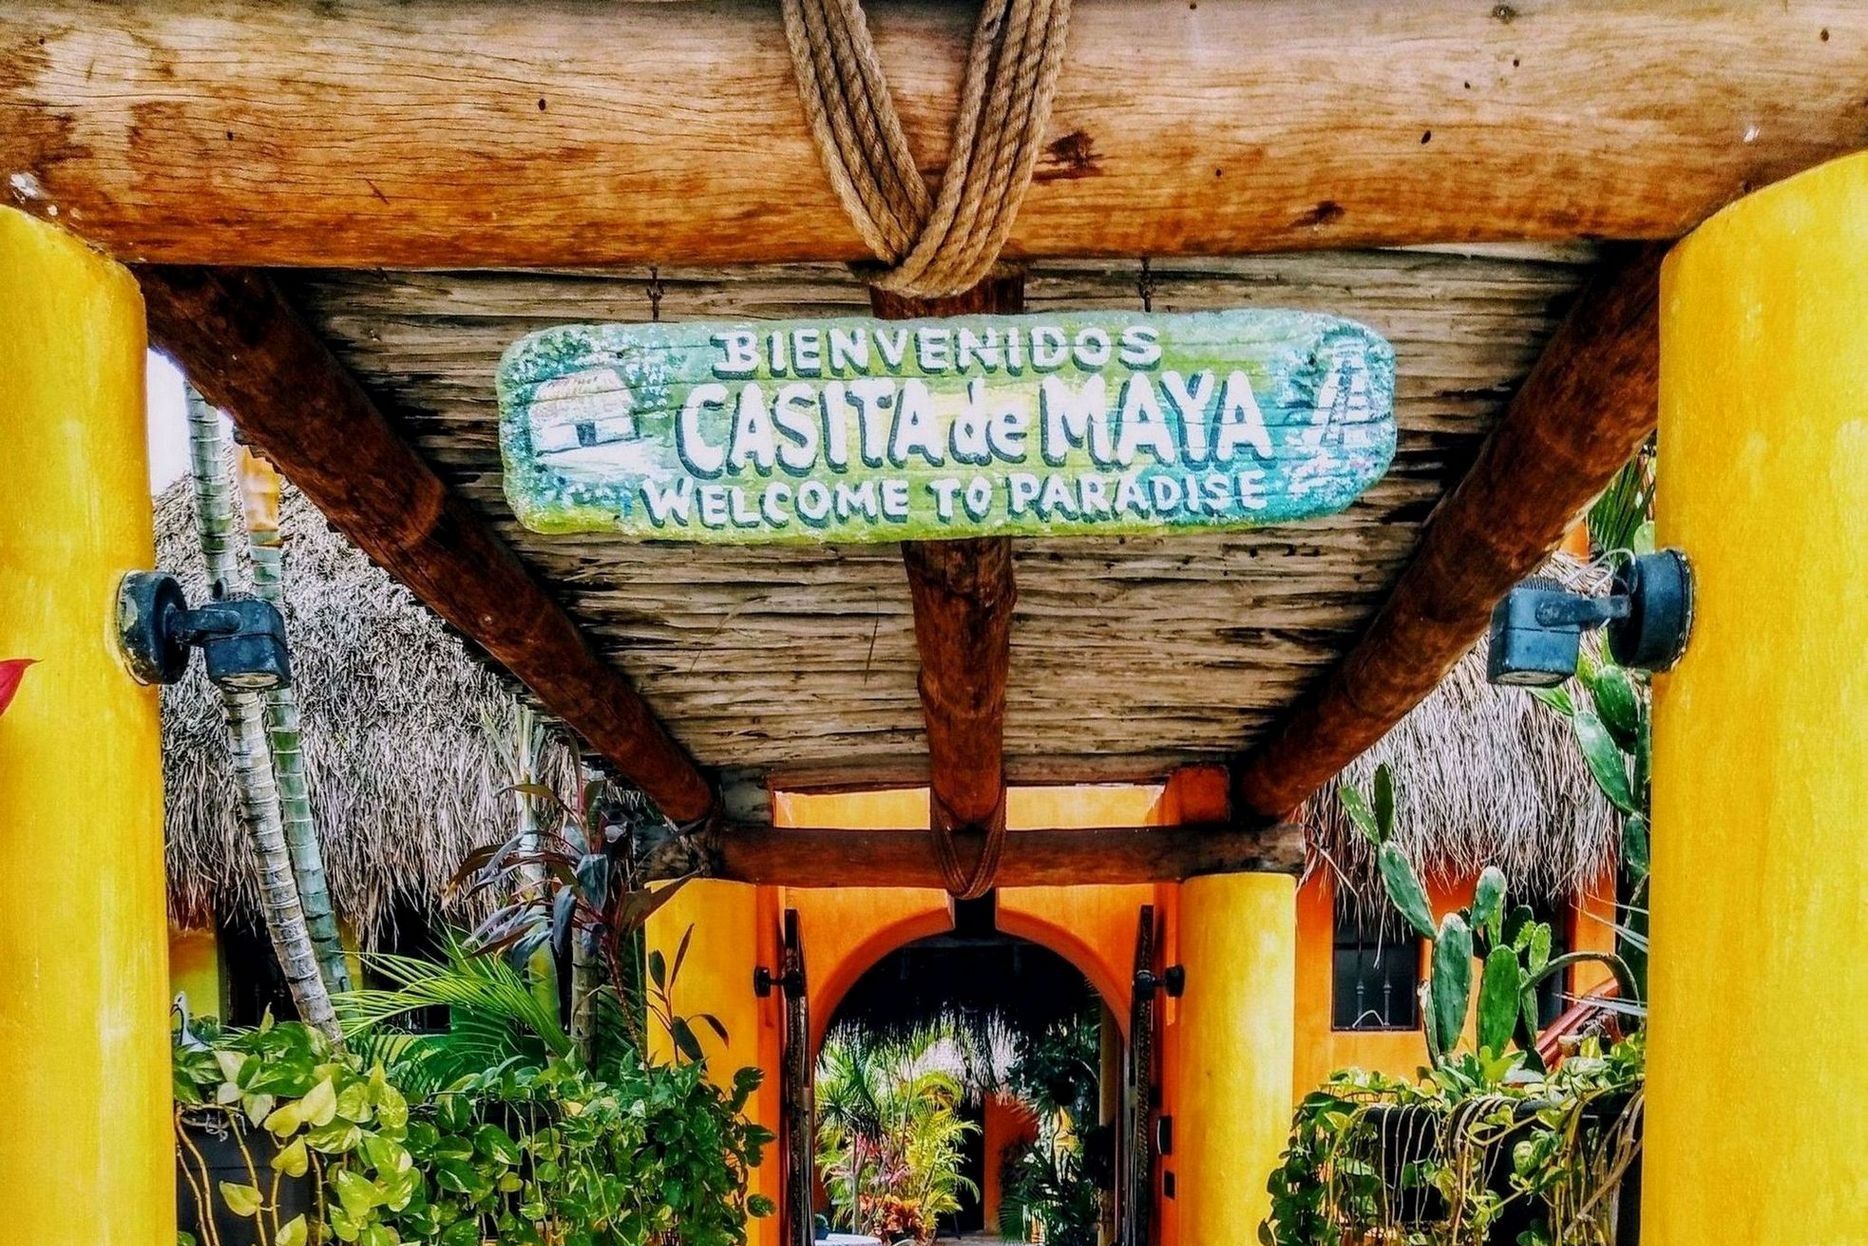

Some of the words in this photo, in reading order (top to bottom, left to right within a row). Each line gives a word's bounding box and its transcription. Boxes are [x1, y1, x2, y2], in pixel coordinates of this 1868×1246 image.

[709, 325, 1163, 380] BIENVENIDOS
[675, 377, 945, 480] CASITA
[948, 377, 1030, 467] de
[1038, 369, 1278, 472] MAYA
[639, 476, 910, 529] WELCOME
[926, 477, 993, 524] TO
[1006, 469, 1269, 523] PARADISE
